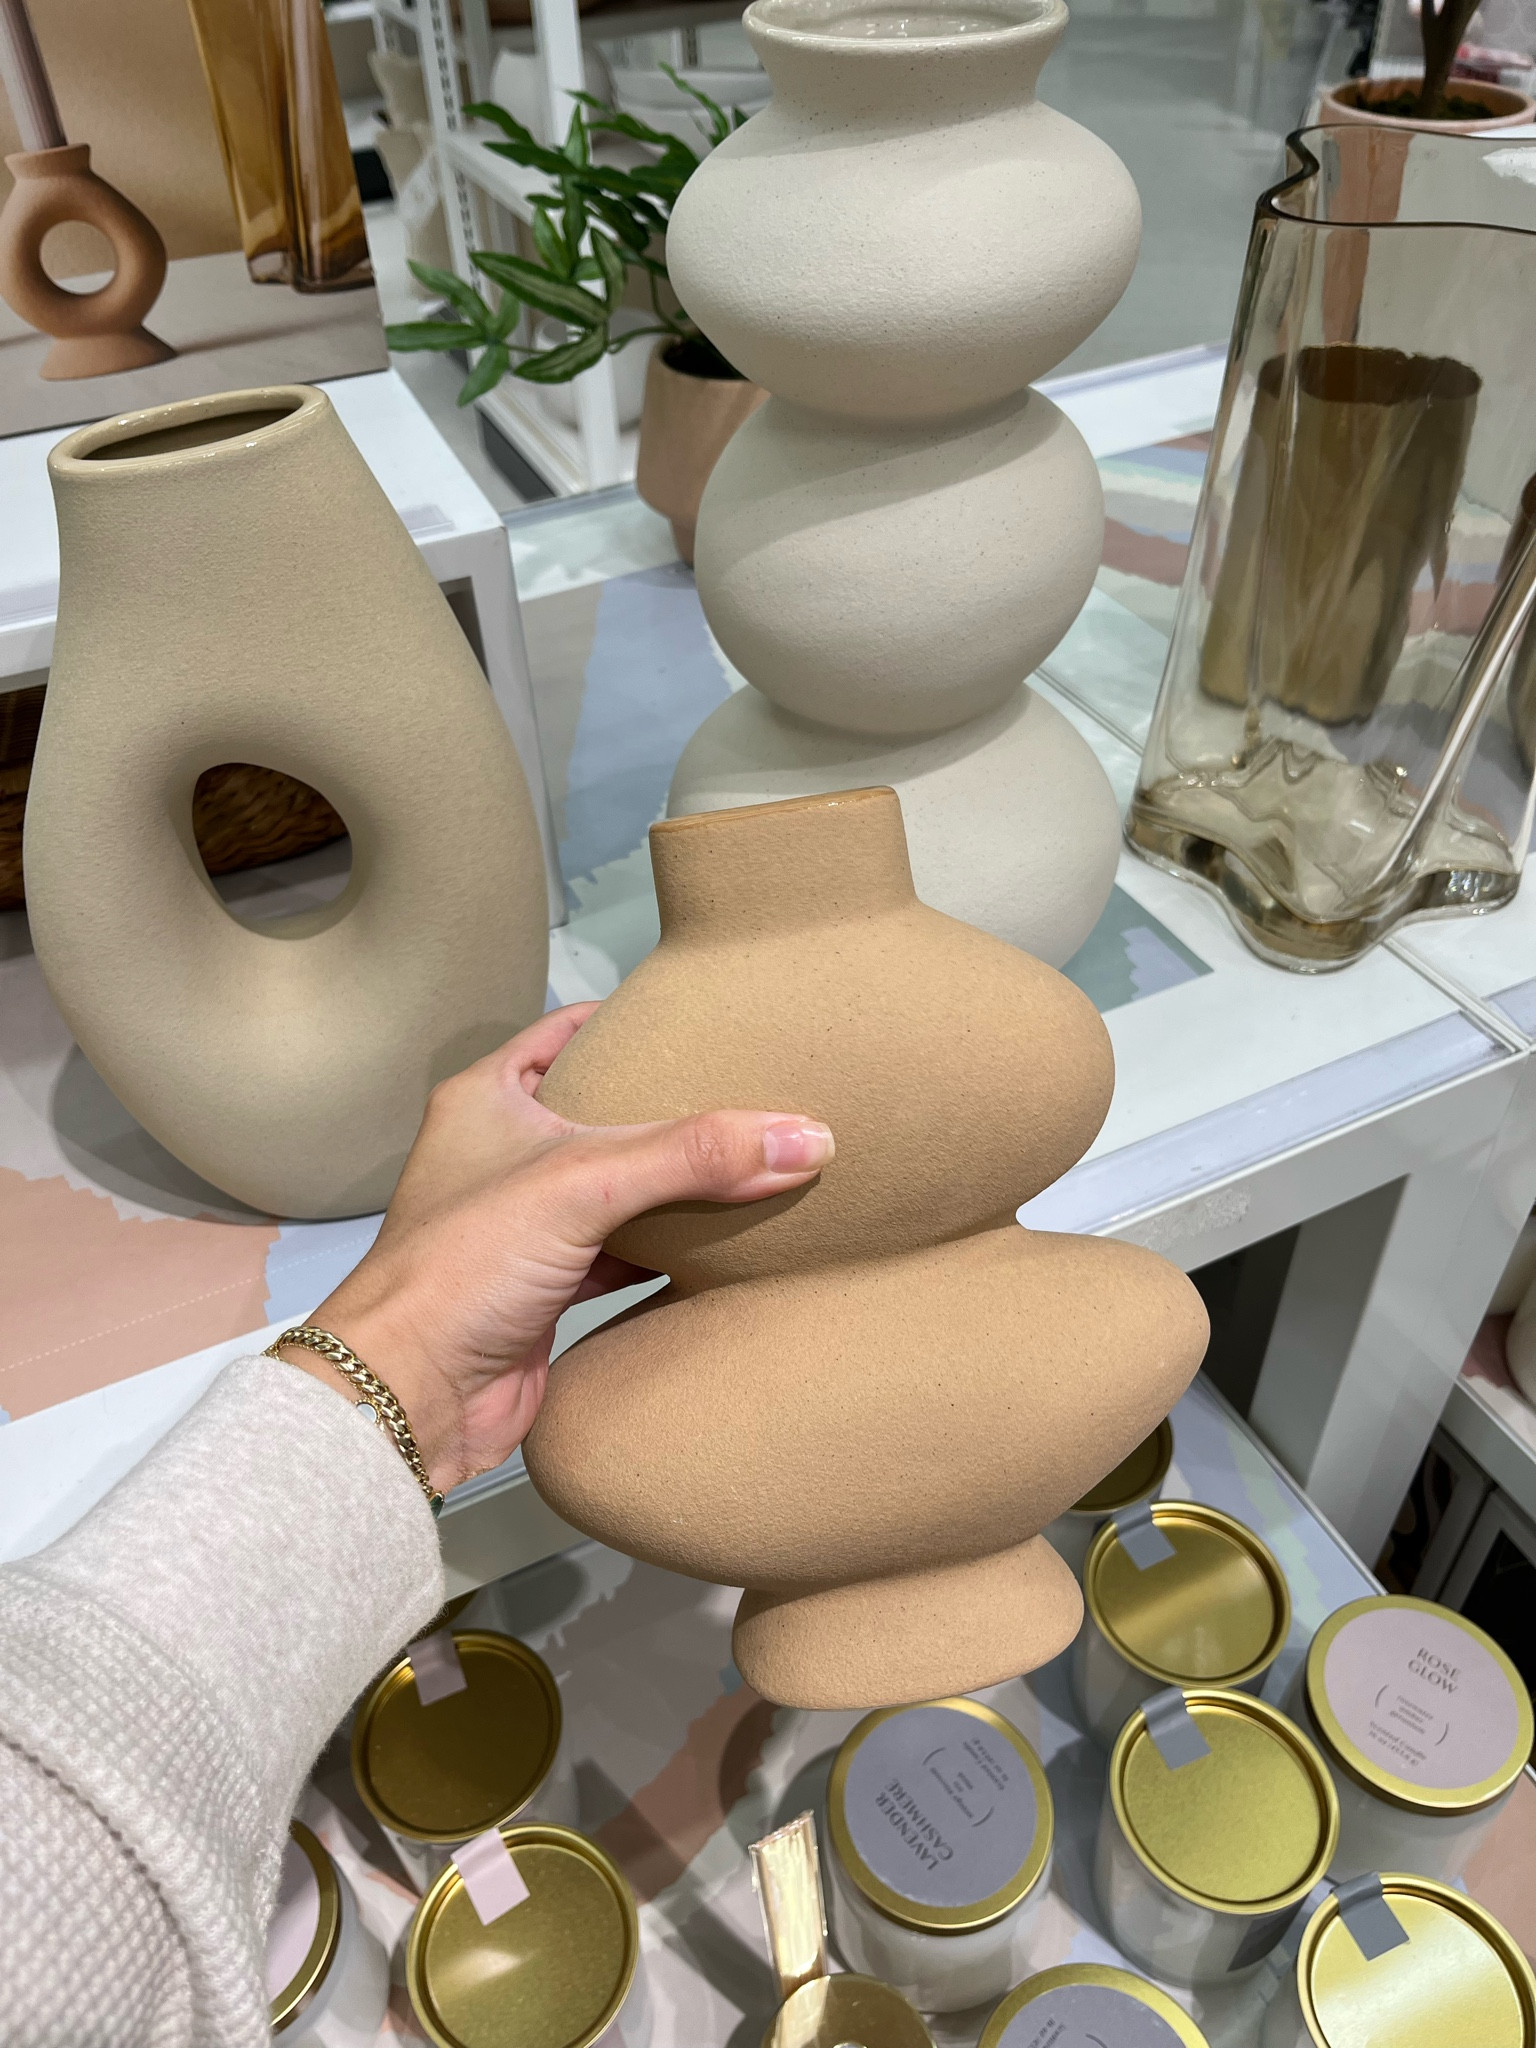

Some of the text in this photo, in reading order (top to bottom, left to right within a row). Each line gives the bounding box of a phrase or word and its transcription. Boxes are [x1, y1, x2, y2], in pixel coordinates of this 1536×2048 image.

[1408, 1659, 1458, 1693] GLOW
[1416, 1647, 1461, 1681] ROSE
[873, 1791, 939, 1870] LAVENDER
[885, 1778, 954, 1862] CASHMERE
